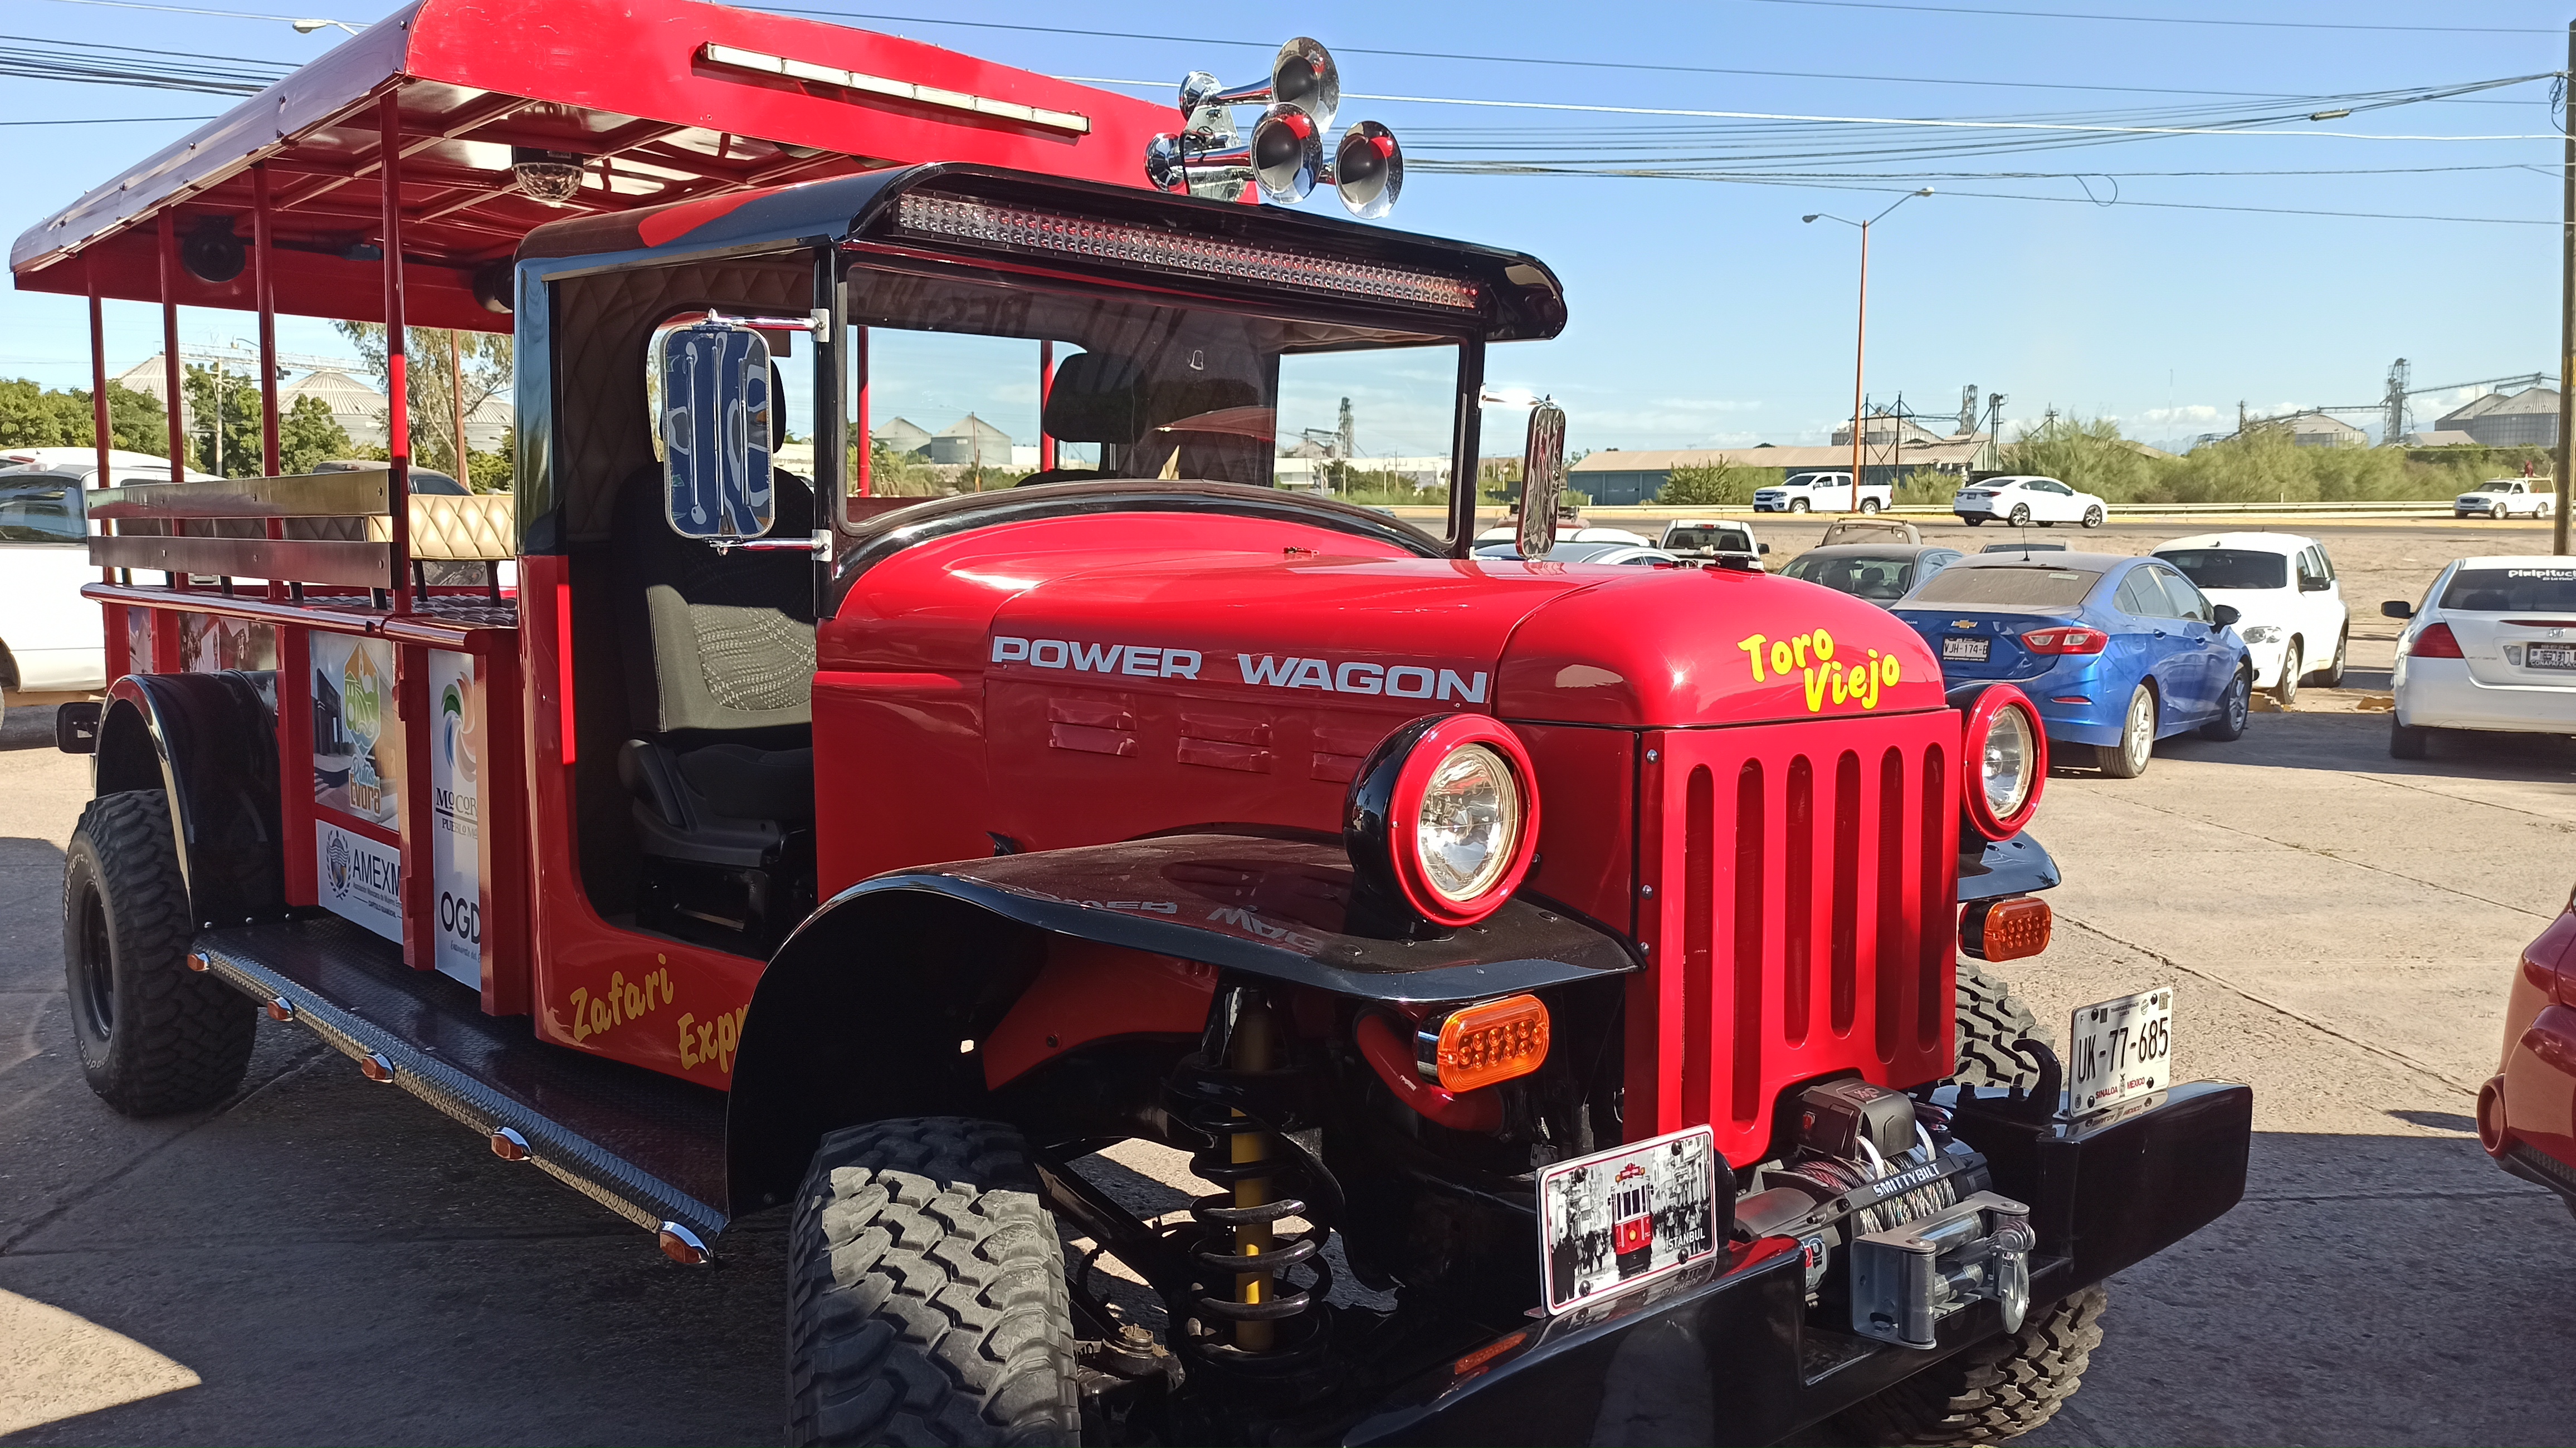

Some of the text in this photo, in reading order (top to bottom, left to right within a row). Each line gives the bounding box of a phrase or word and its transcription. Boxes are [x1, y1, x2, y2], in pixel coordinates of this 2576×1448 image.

[992, 635, 1487, 704] POWER WAGON
[1737, 628, 1834, 683] Toro
[1803, 648, 1901, 712] Viejo
[570, 953, 674, 1043] Zafari
[2077, 1017, 2169, 1084] UK-77-685
[2095, 1086, 2118, 1099] SINALOA
[1872, 1163, 1940, 1197] SMITTYBILT
